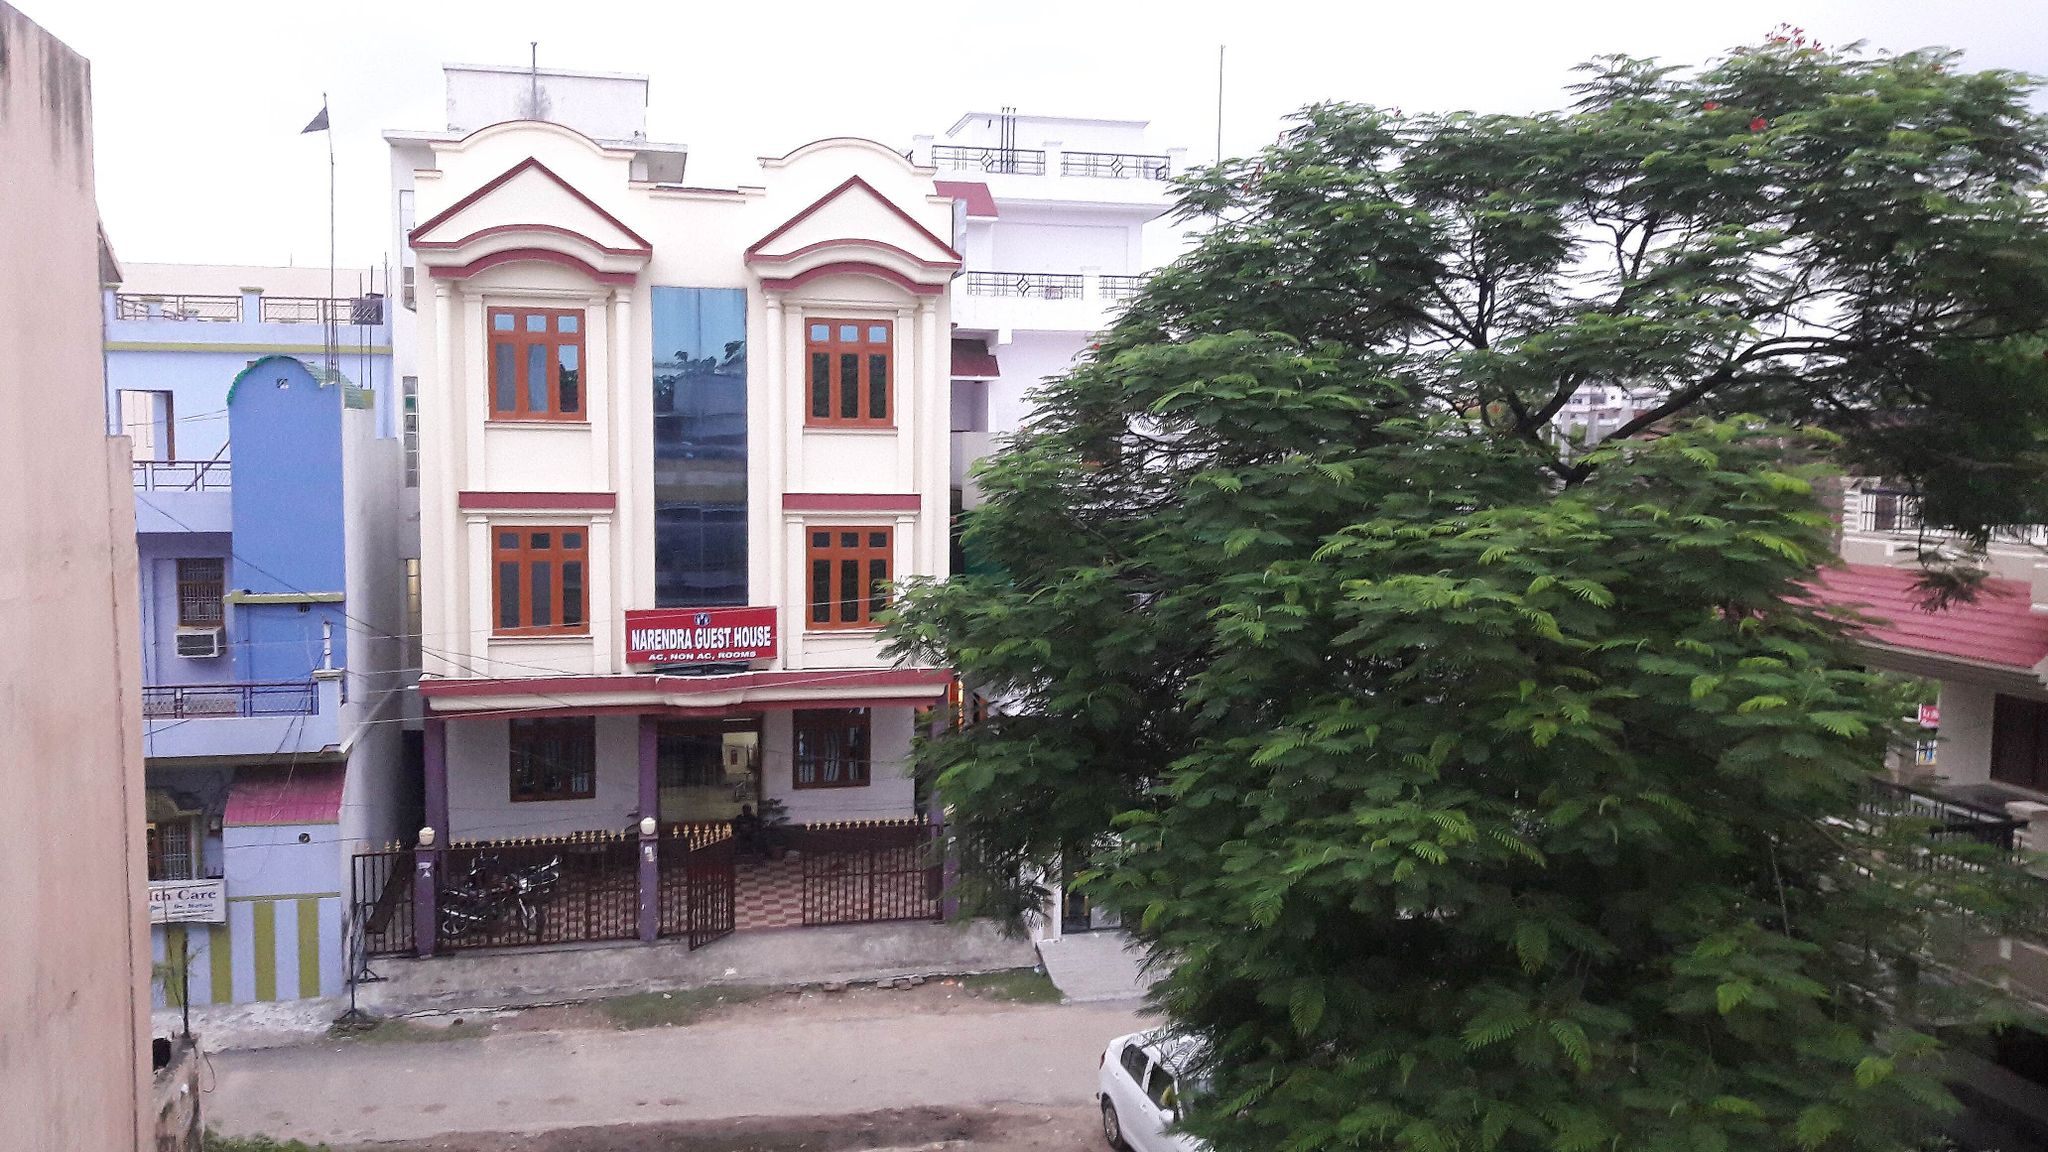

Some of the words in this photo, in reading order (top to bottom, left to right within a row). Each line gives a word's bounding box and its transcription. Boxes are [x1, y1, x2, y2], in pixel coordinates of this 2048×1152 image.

[631, 629, 692, 650] NARENDRA
[694, 627, 731, 649] GUEST
[734, 626, 771, 648] HOUSE
[648, 653, 667, 662] AC,
[670, 653, 694, 661] NON
[696, 652, 715, 661] AC,
[718, 651, 756, 659] ROOMS
[178, 890, 217, 900] Care
